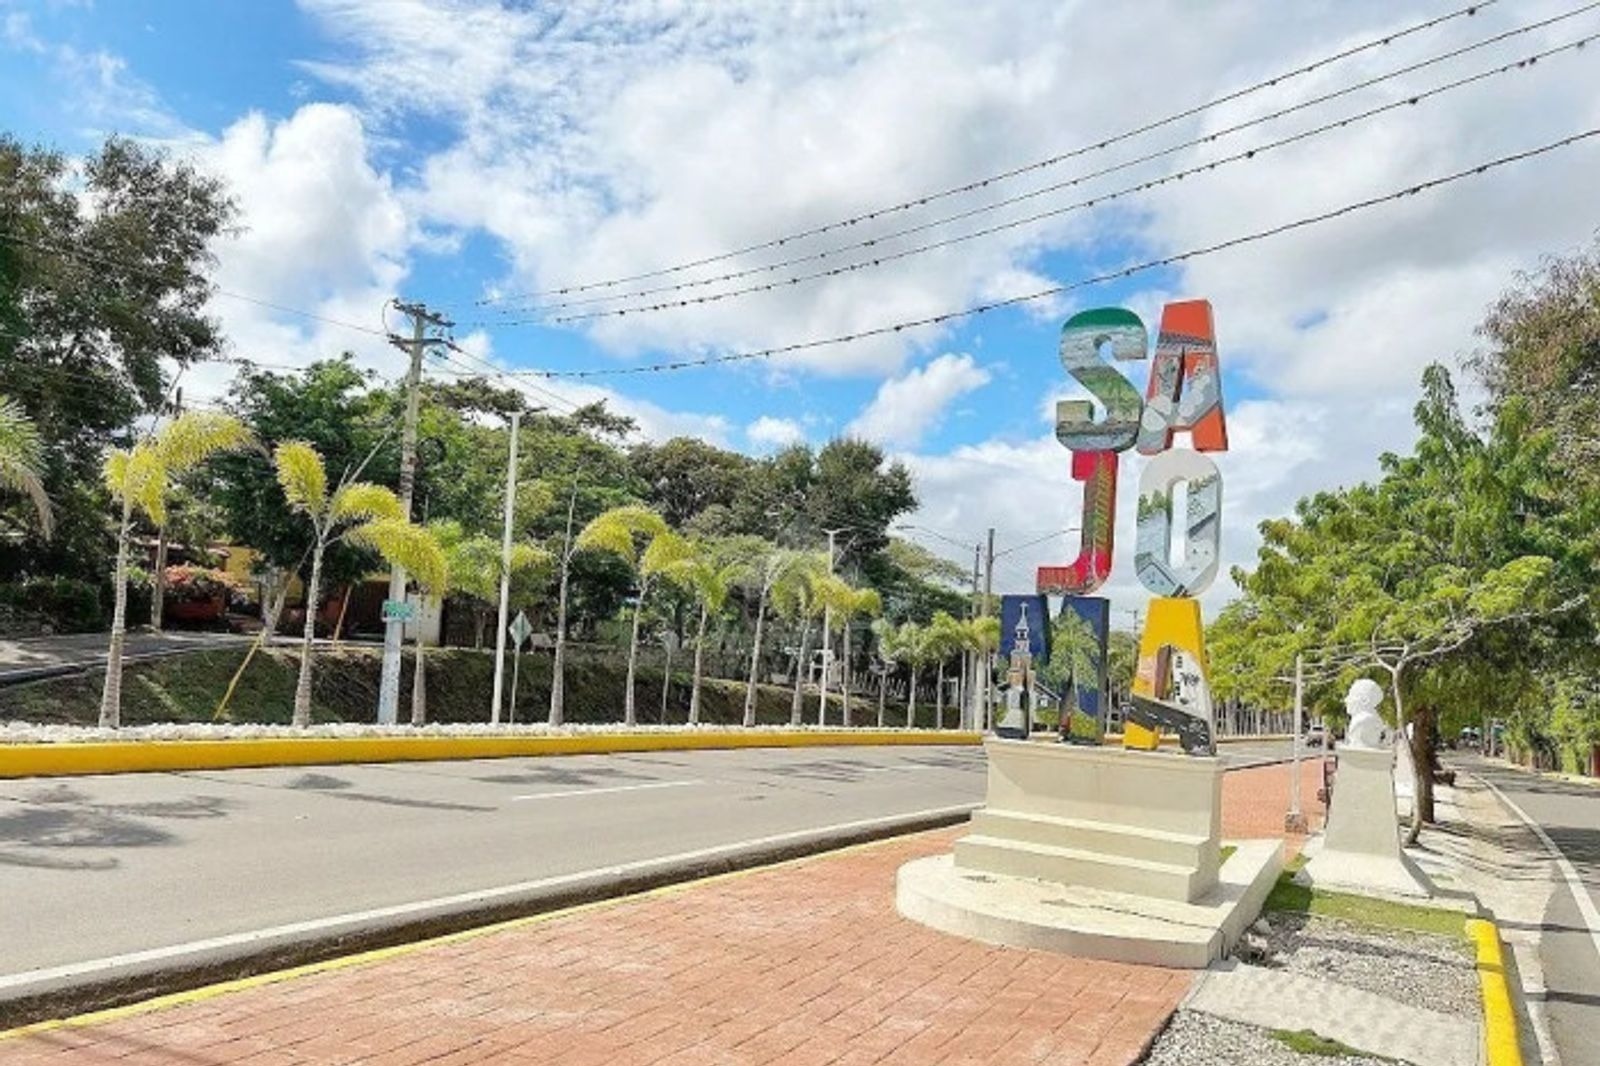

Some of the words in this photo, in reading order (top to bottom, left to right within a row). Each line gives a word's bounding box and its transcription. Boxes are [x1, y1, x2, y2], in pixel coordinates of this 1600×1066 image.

[1056, 299, 1229, 455] SA
[1036, 449, 1223, 597] JO
[995, 594, 1217, 757] MA
